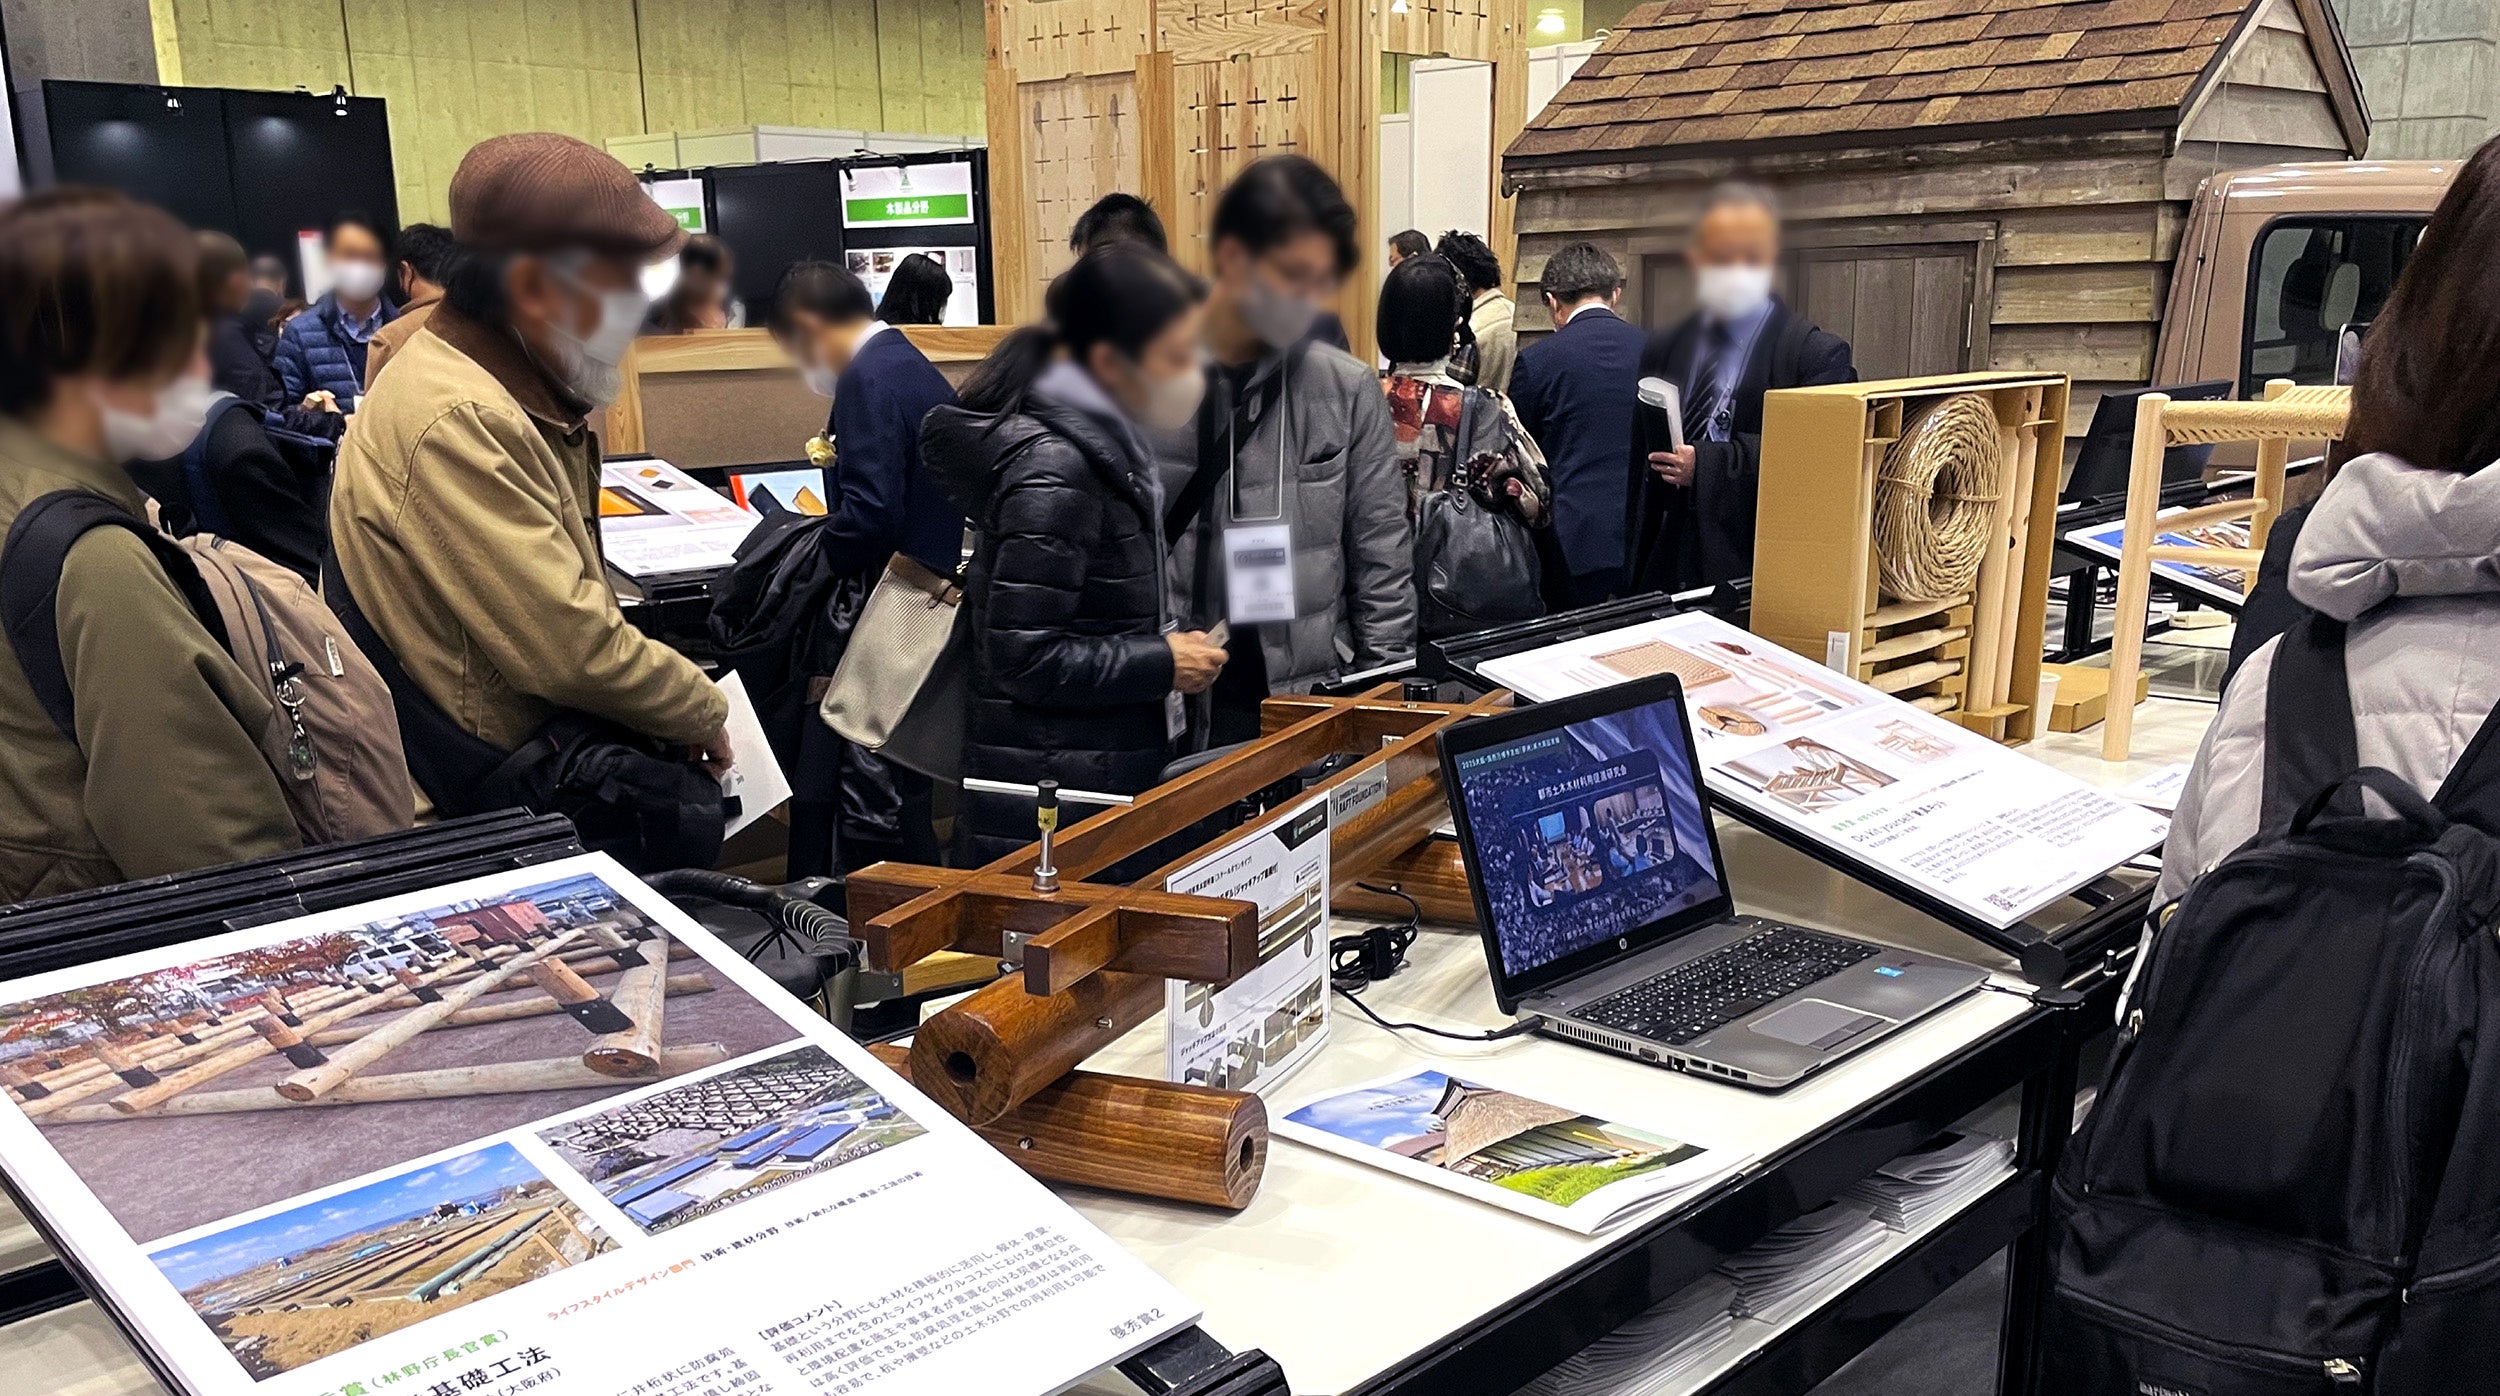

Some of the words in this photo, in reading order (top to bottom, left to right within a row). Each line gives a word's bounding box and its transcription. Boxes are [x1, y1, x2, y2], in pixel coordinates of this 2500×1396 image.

[547, 1258, 696, 1321] ライフスタイルデザイン部門
[700, 1226, 780, 1262] 技術・建材分野
[758, 1299, 843, 1341] 【評価コメント】
[783, 1234, 1069, 1364] 再利用までを含めたライフサイクルコストにおける優位性
[1109, 1307, 1166, 1341] 優秀賞2
[318, 1329, 509, 1396] 賞（林野庁長官賞）
[412, 1346, 552, 1396] 基礎工法
[655, 1358, 748, 1396] 工法です。基
